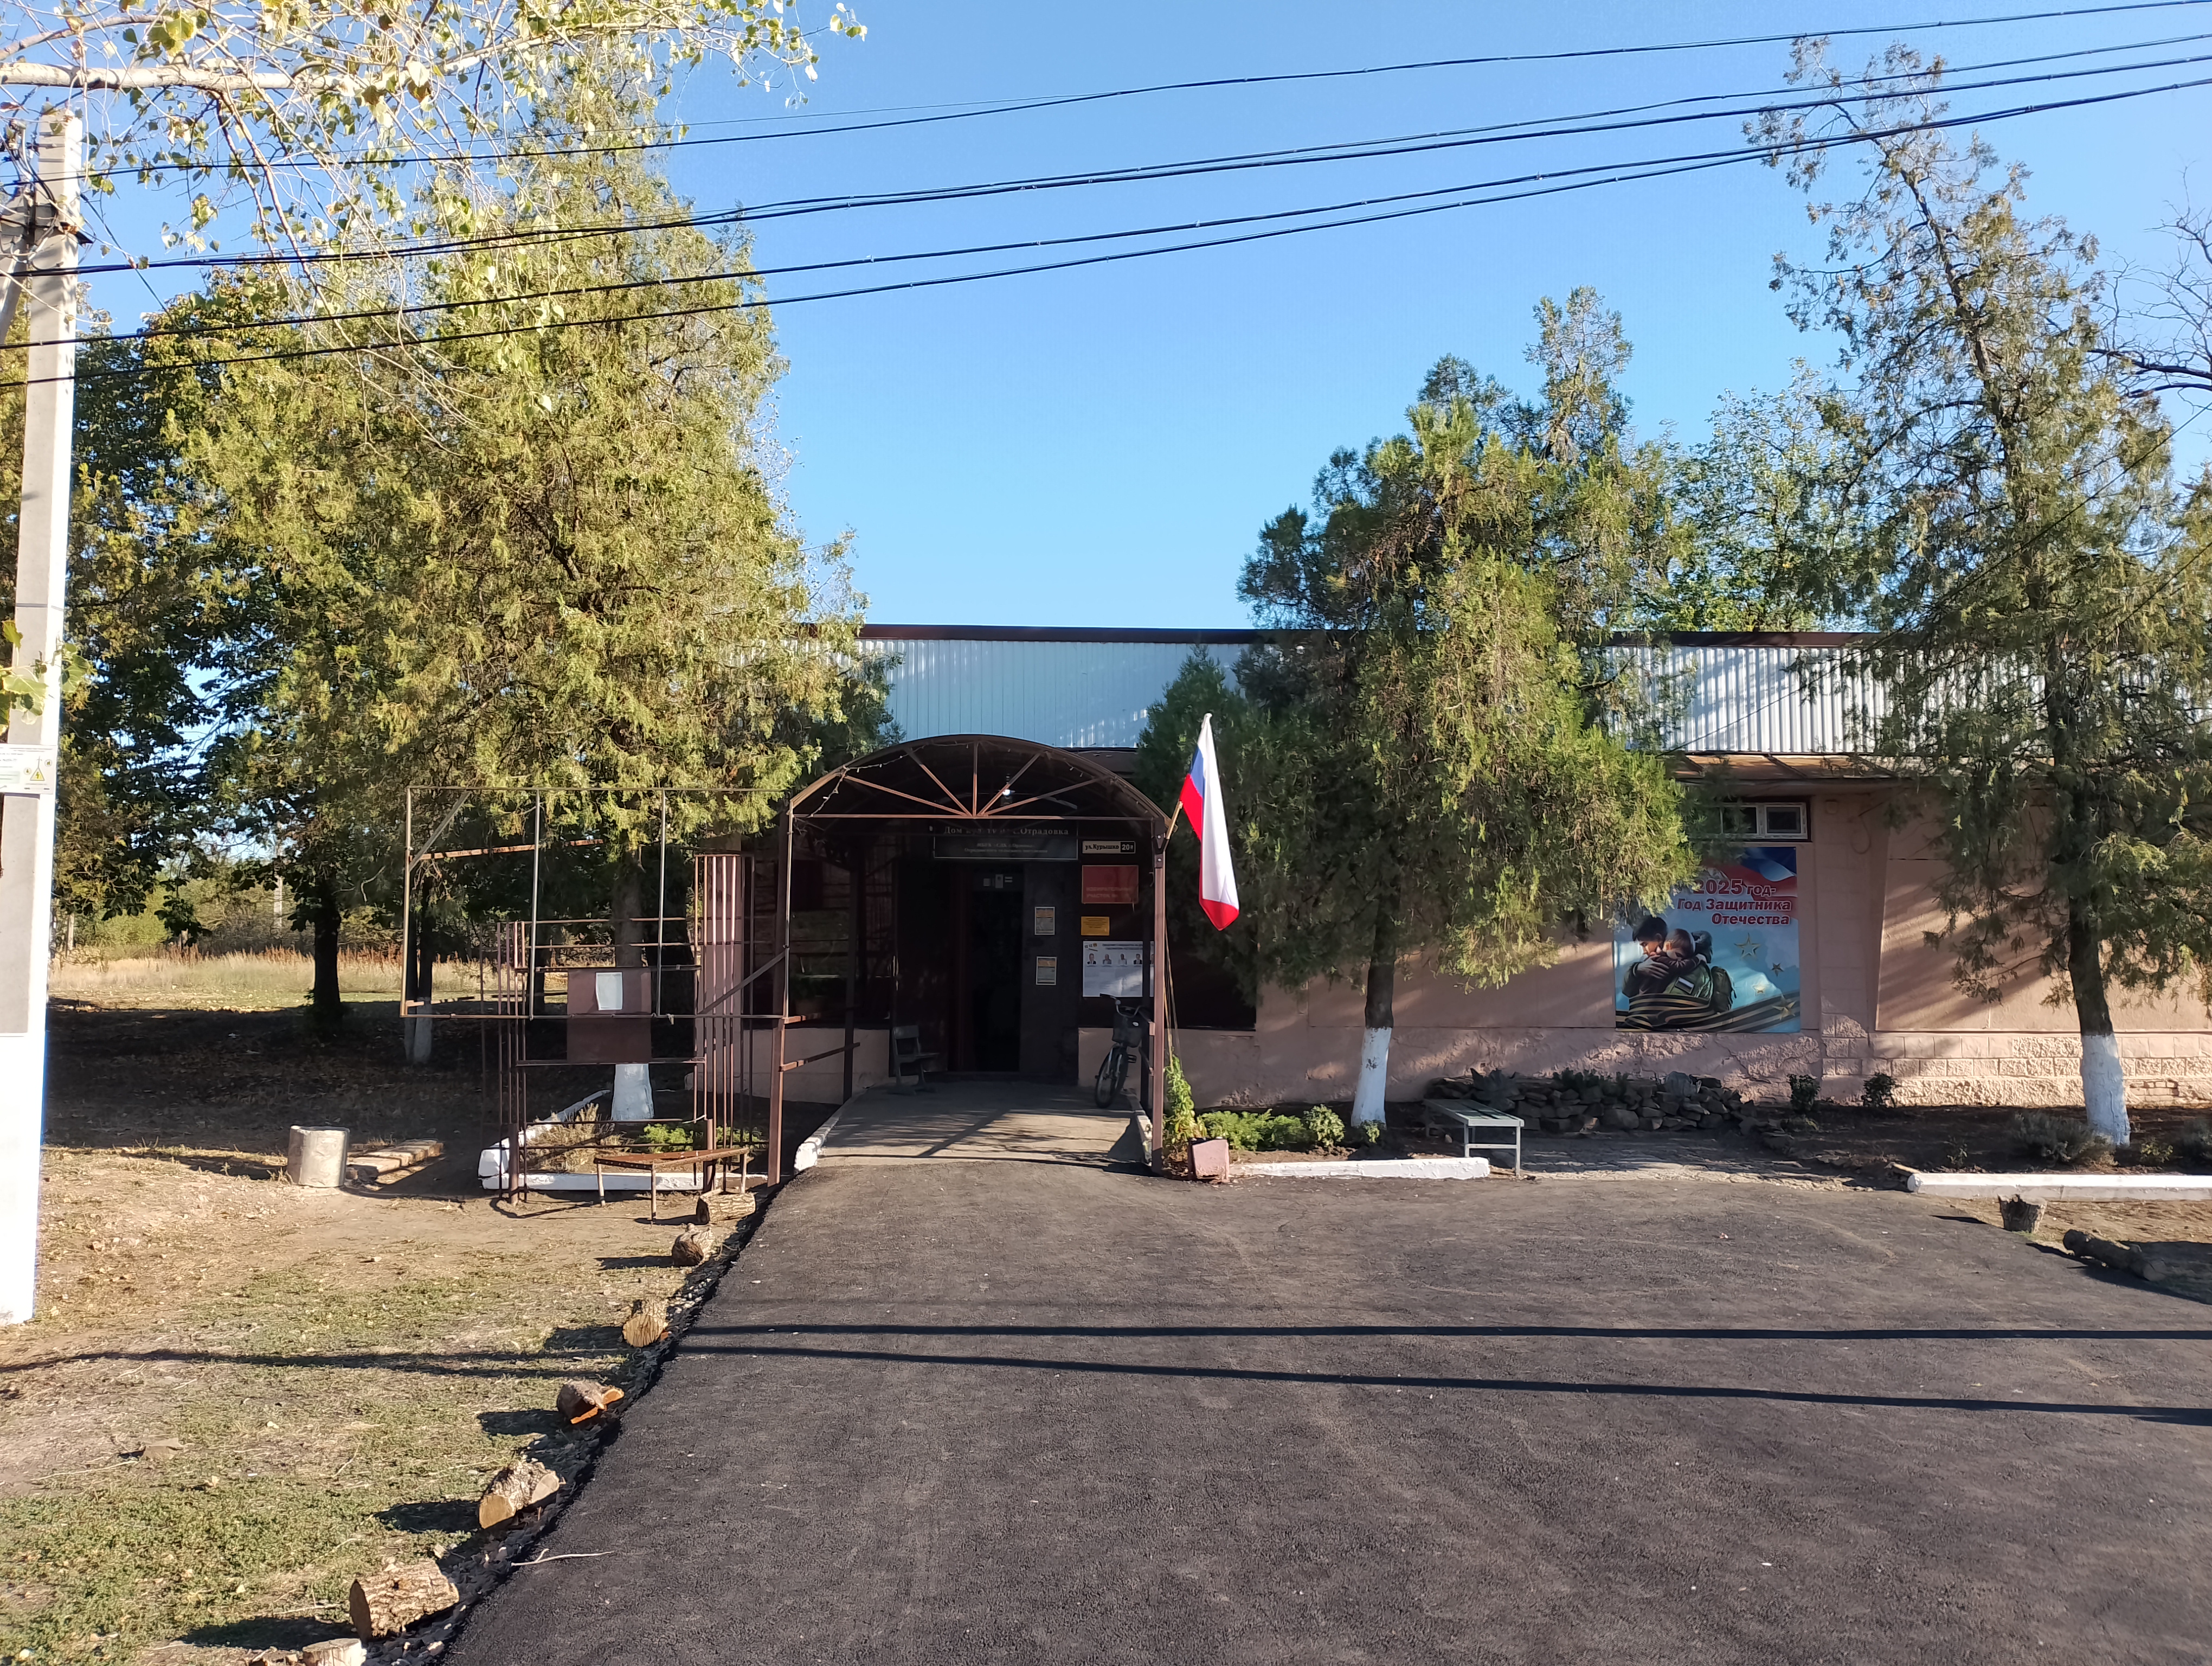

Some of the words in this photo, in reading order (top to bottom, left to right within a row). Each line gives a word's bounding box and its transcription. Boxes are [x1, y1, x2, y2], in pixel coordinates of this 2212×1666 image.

[944, 826, 962, 835] Дом
[1693, 879, 1743, 895] 2025
[1677, 898, 1702, 912] Год
[1706, 898, 1792, 912] Защитника
[1712, 913, 1790, 925] Отечества
